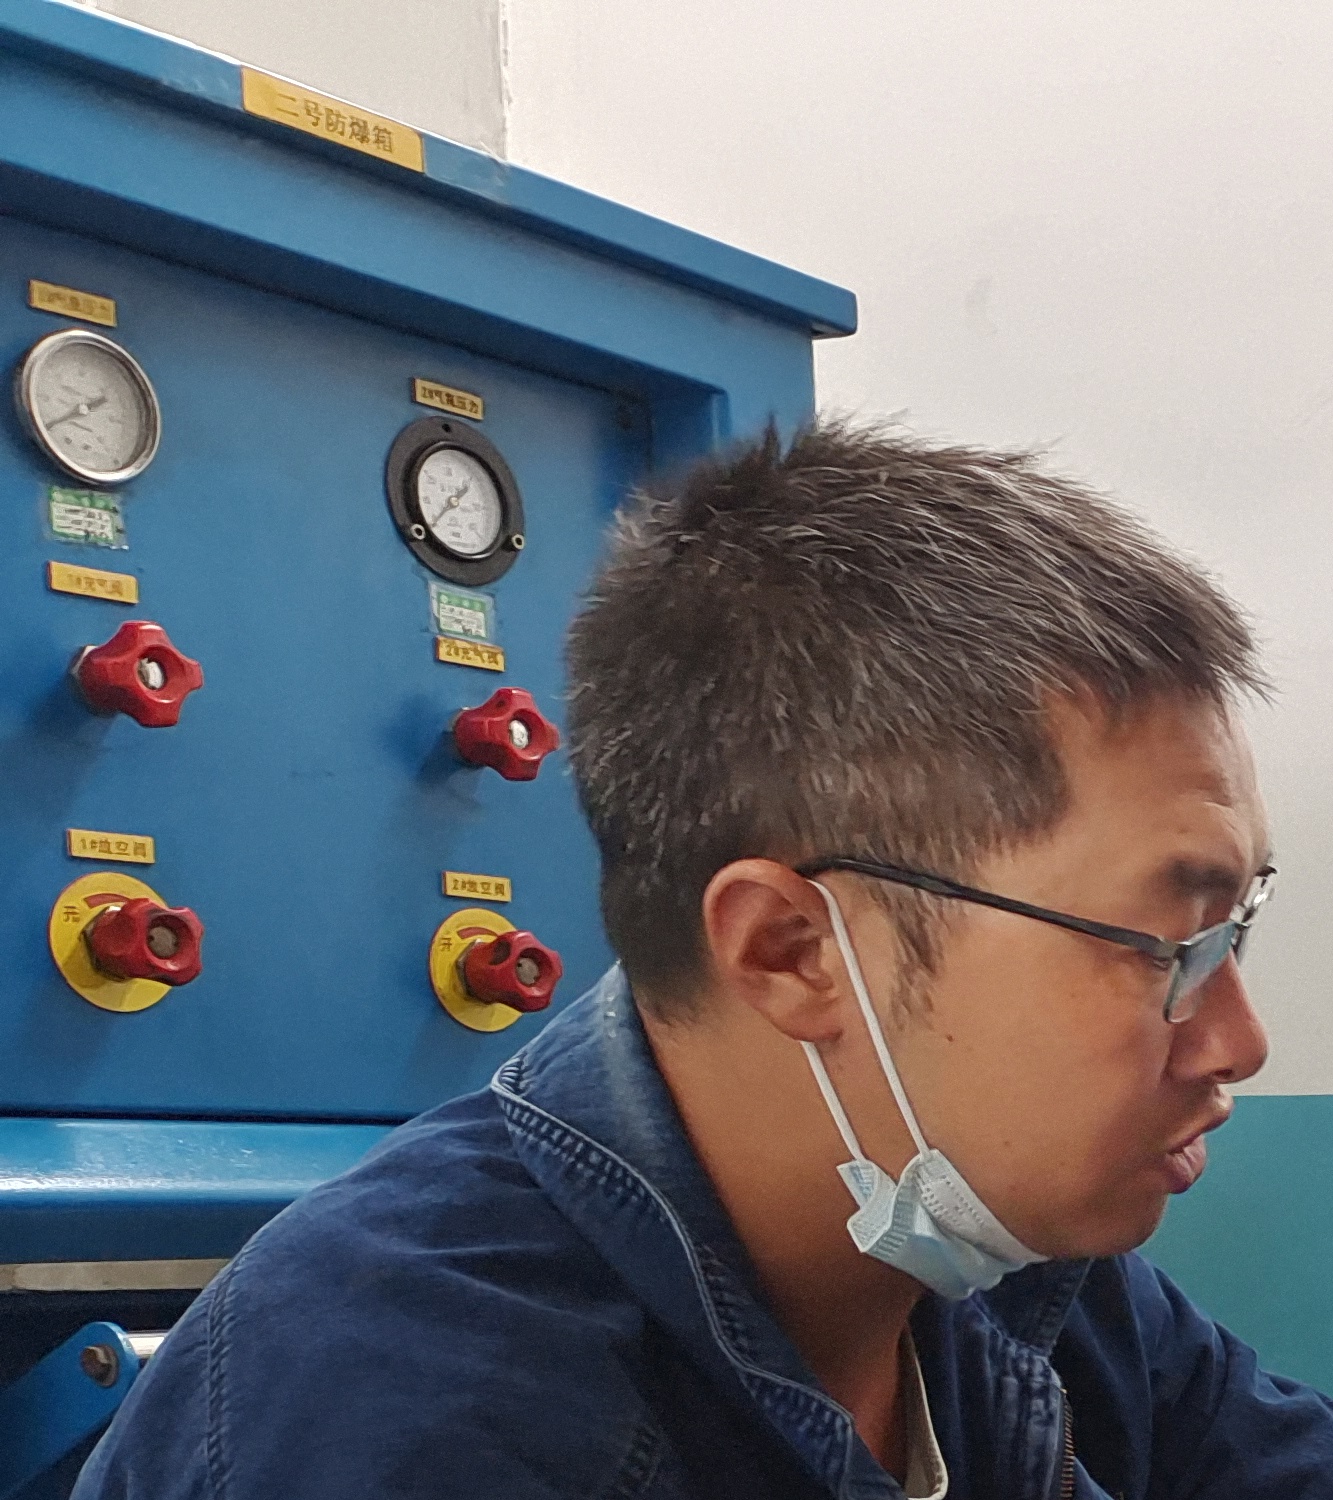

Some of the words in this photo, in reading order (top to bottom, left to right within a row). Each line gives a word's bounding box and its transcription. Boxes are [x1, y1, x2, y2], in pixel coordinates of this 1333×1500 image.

[276, 92, 394, 154] 二号防爆箱
